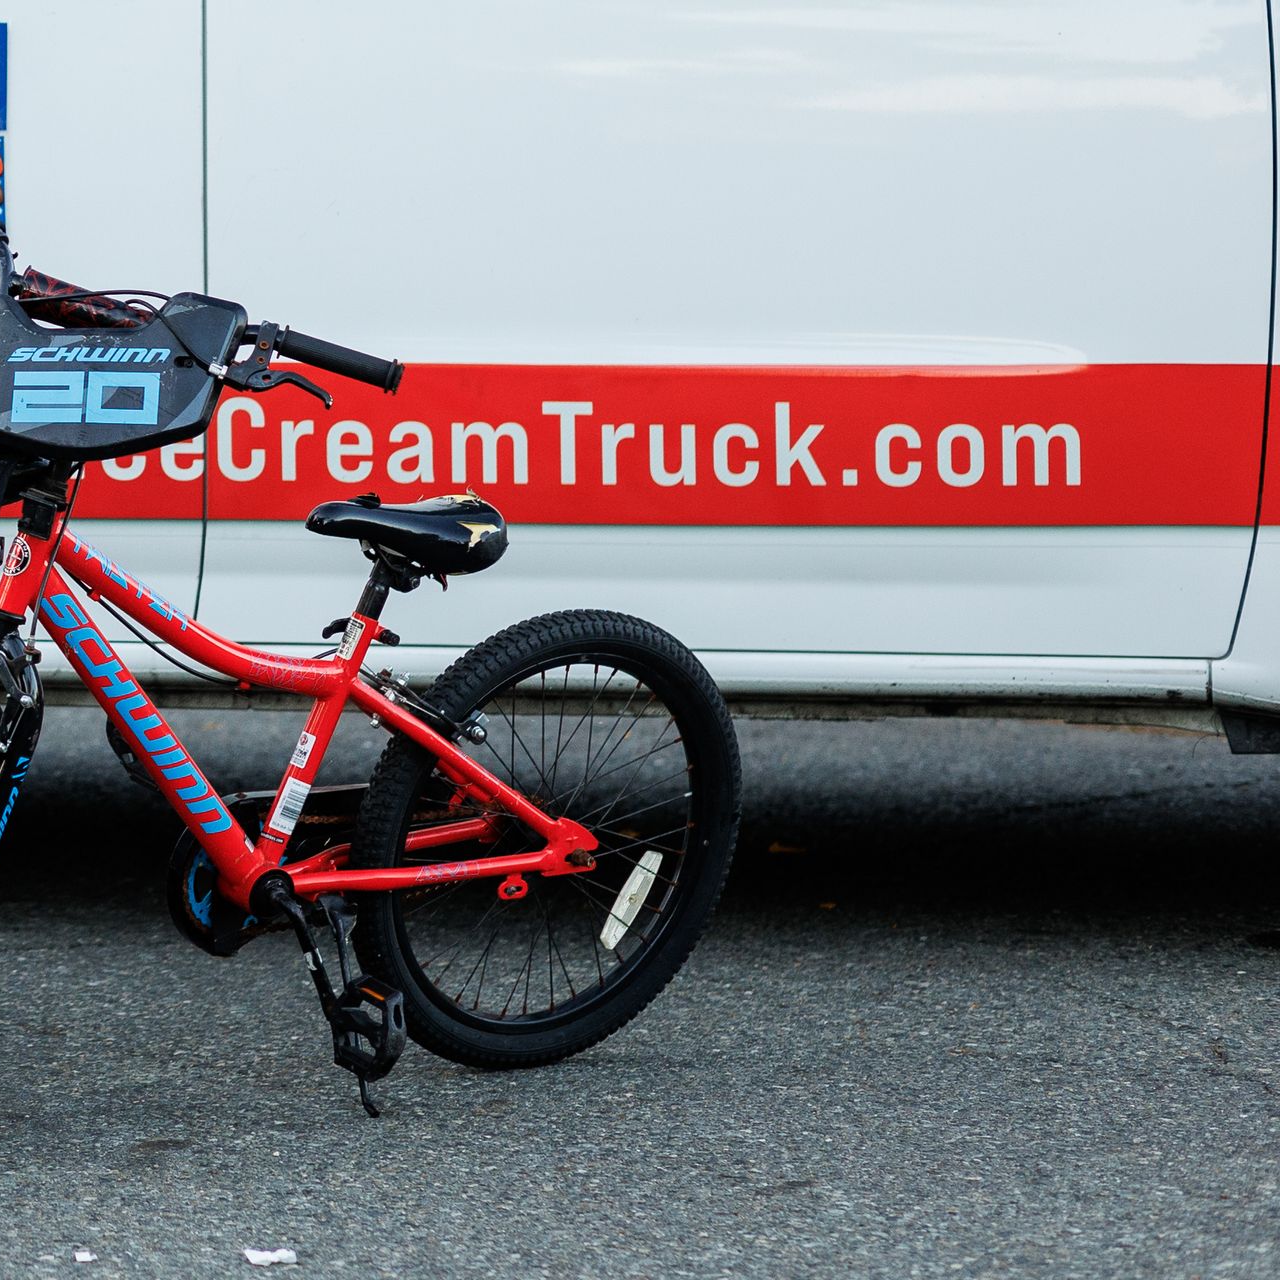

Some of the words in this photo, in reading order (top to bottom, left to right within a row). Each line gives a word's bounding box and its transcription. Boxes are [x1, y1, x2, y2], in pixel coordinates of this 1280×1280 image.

[7, 347, 171, 363] SCHWINN
[10, 370, 161, 425] 20
[40, 592, 233, 835] SCHWINN
